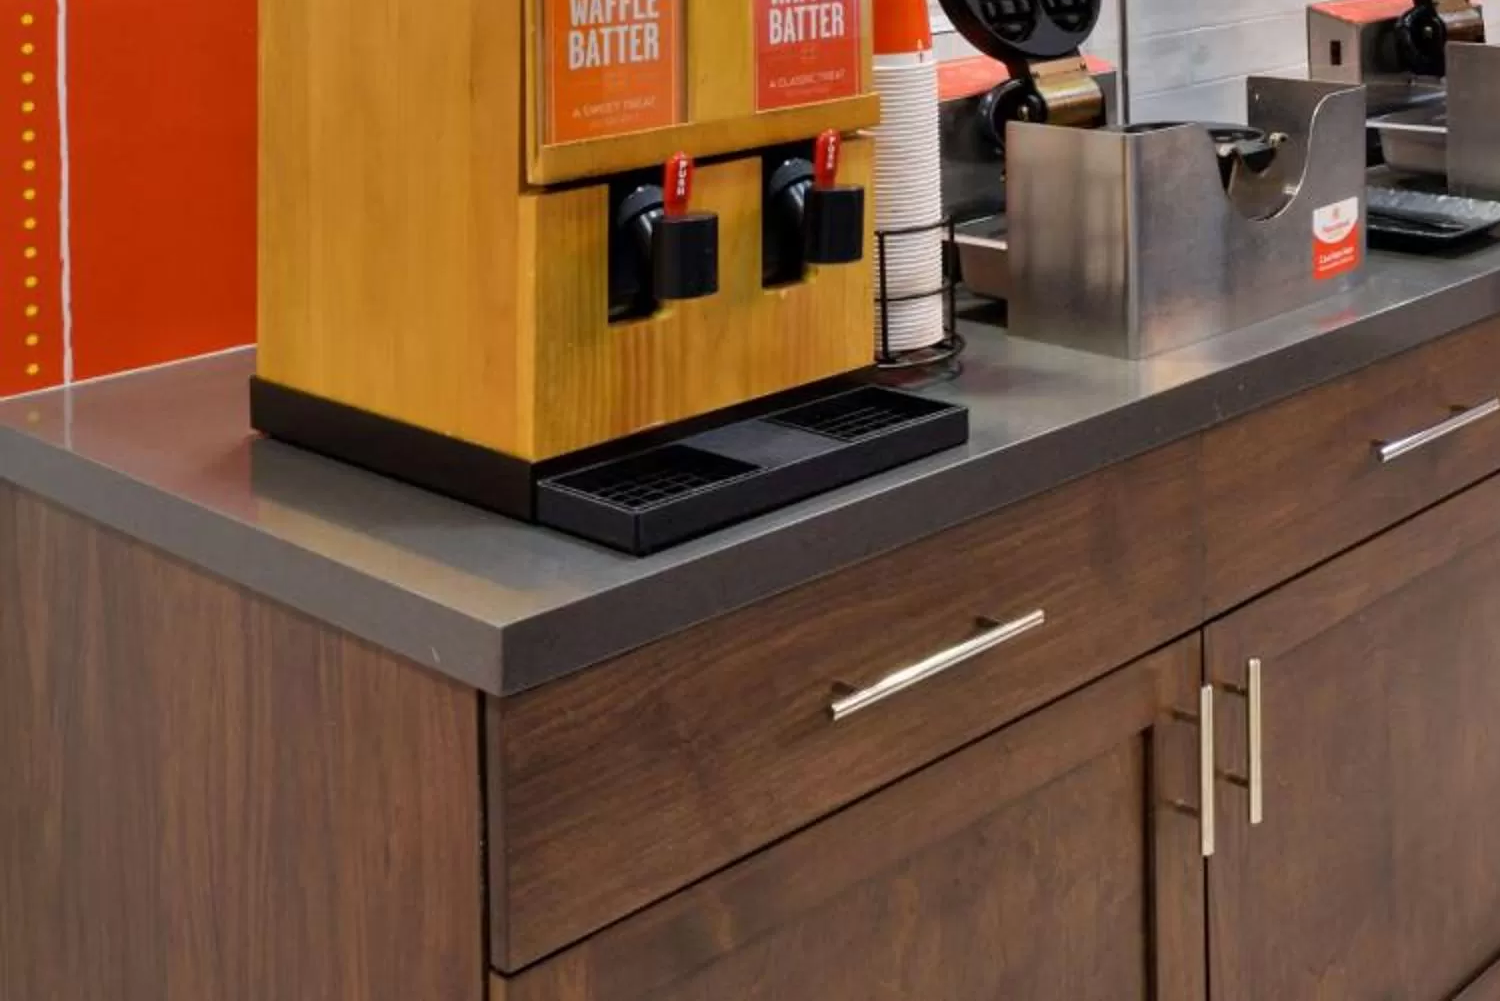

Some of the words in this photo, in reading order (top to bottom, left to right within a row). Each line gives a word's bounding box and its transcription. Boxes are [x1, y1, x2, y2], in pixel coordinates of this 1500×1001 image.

[769, 2, 845, 46] BATTER
[568, 22, 660, 71] BATTER
[676, 160, 688, 196] PUSH
